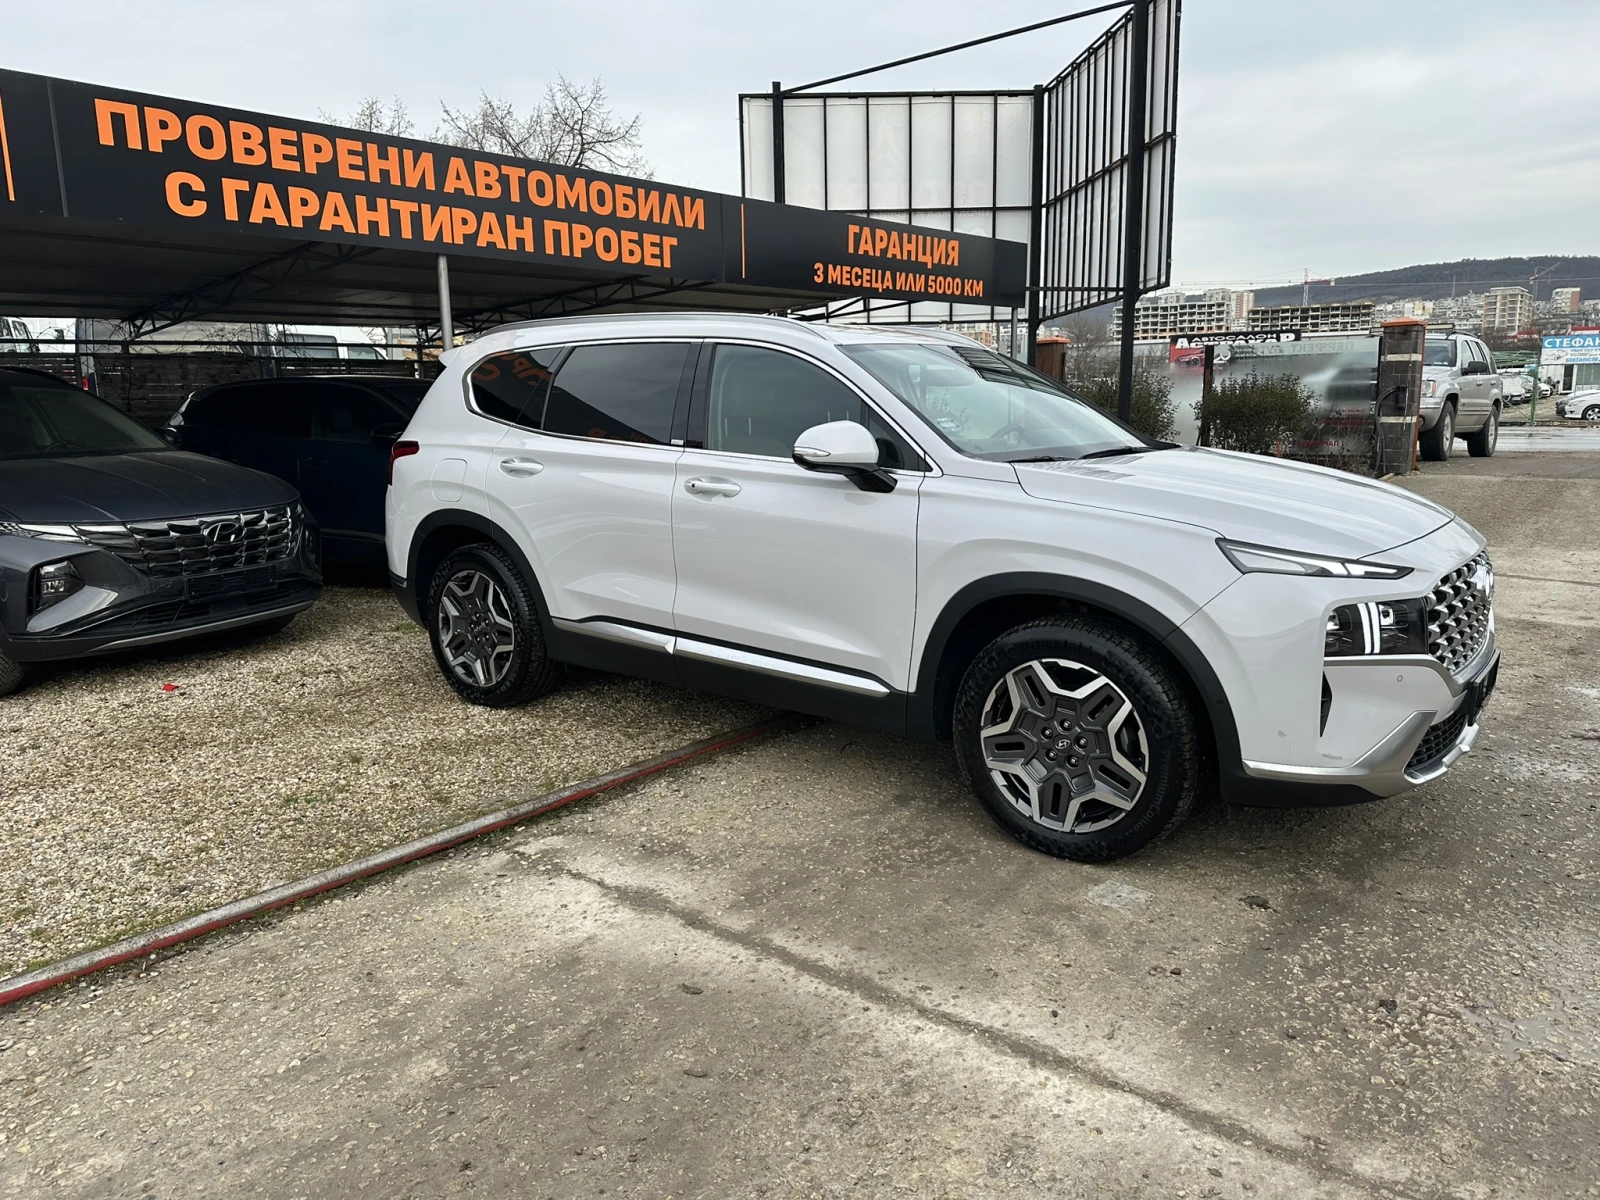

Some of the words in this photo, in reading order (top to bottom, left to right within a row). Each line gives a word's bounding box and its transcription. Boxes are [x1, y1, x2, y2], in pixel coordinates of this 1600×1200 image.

[94, 98, 436, 191] ПРОВЕРЕНИ
[443, 156, 705, 231] АВТОМОБИЛИ
[164, 171, 208, 218] С
[221, 177, 535, 253] ГАРАНТИРАН
[543, 219, 678, 269] ПРОБЕГ
[848, 224, 960, 269] ГАРАНЦИЯ
[814, 262, 825, 284] 3
[827, 265, 893, 292] МЕСЕЦА
[896, 272, 926, 291] ИЛИ
[927, 276, 962, 296] 5000
[964, 279, 984, 298] КМ
[1191, 333, 1277, 342] АВТОСАЛОН
